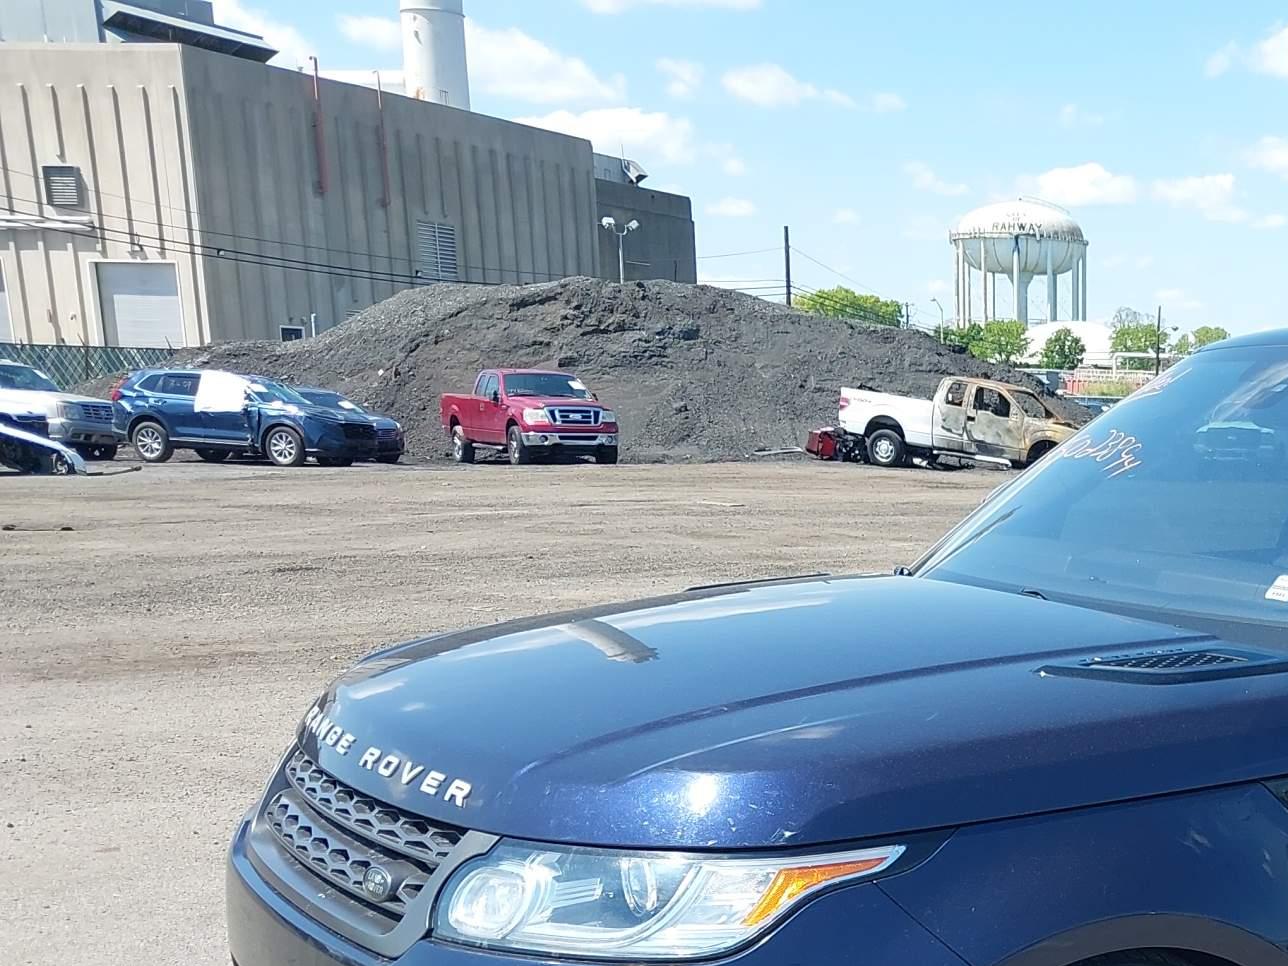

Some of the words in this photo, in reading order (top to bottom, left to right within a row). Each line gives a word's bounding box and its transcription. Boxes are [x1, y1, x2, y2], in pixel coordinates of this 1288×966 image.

[992, 222, 1042, 232] RAHWAY
[305, 706, 356, 756] RANGE
[358, 746, 472, 808] ROVER
